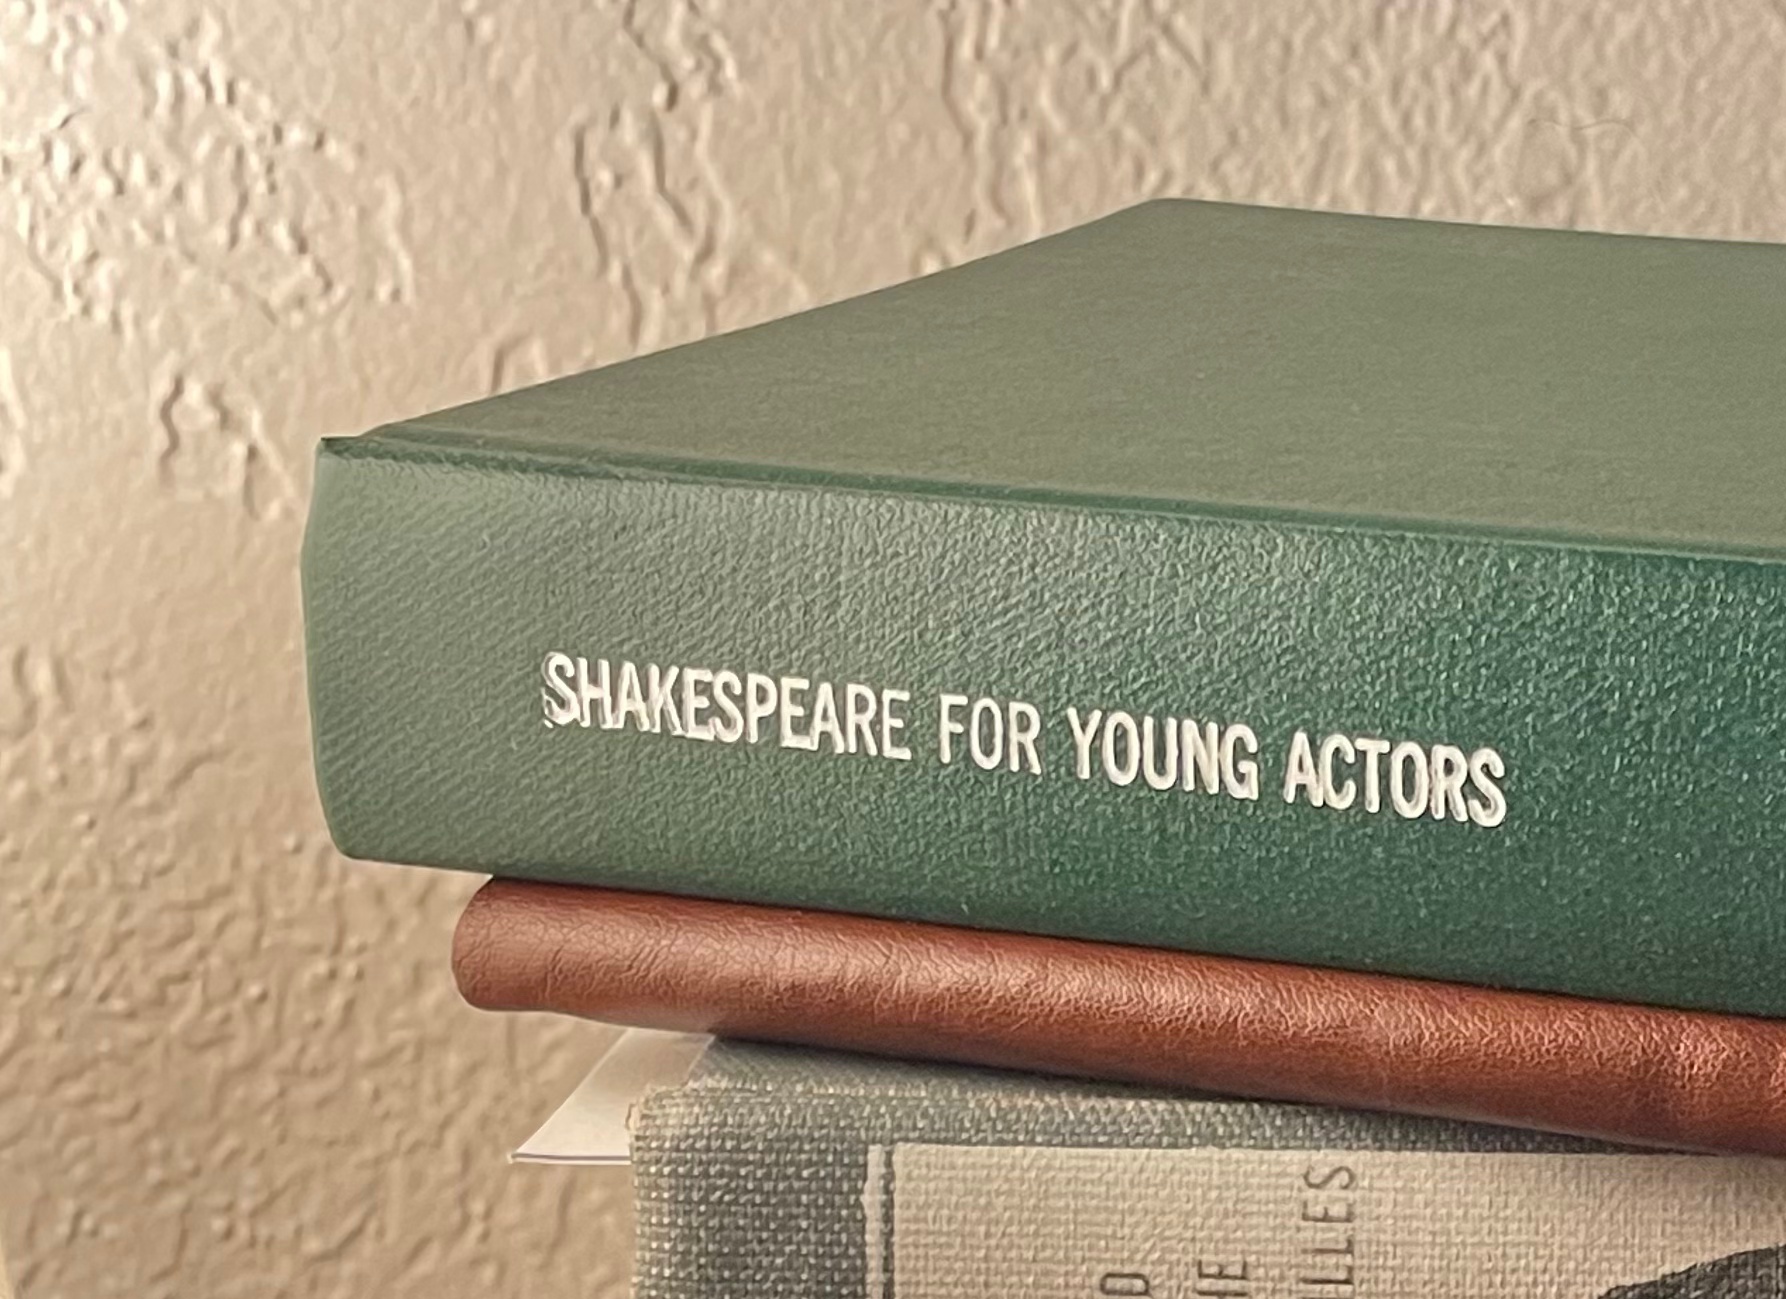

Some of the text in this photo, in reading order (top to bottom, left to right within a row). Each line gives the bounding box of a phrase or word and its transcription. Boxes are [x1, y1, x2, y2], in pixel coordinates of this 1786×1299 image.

[541, 651, 1508, 828] SHAKESPEARE FOR YOUNG ACTORS
